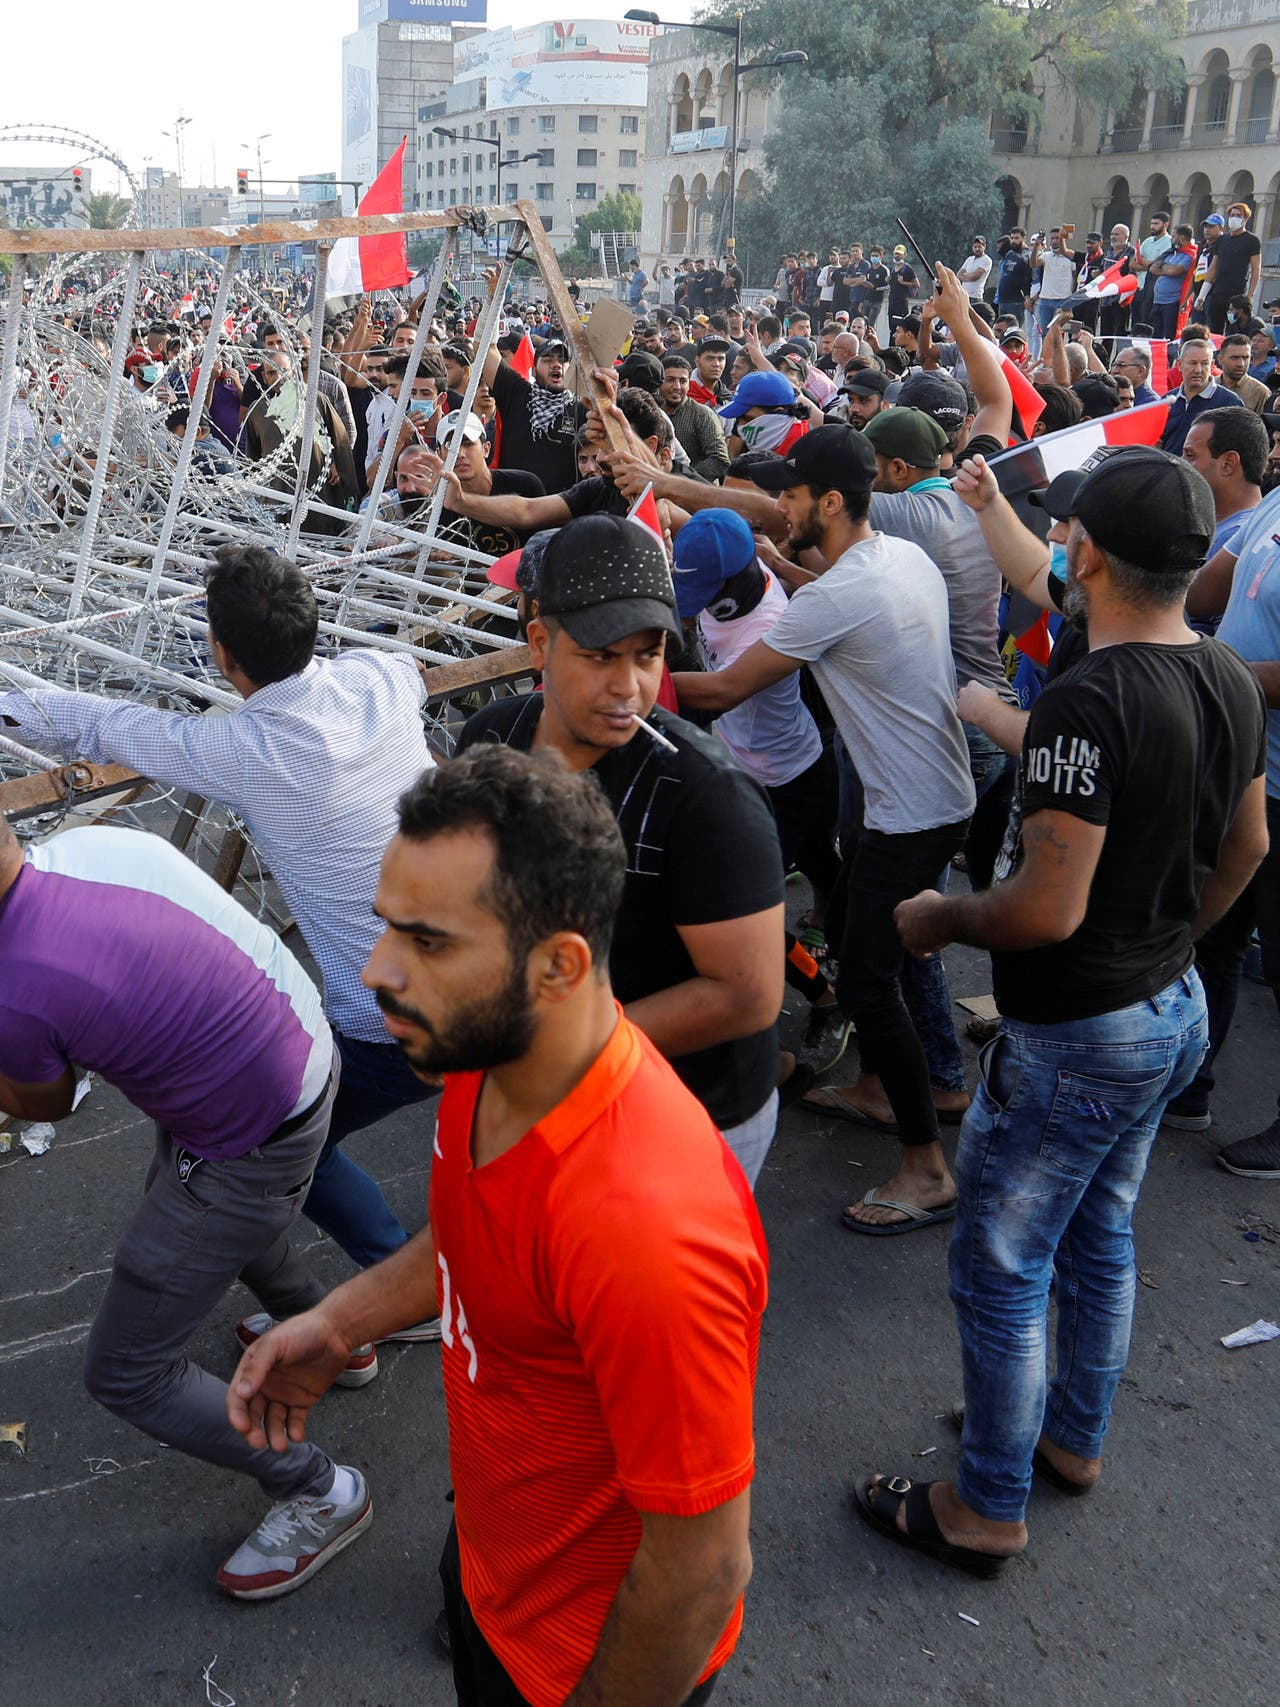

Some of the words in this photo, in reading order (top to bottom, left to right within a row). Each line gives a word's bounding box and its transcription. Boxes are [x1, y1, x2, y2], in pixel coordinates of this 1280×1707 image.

[409, 0, 468, 8] SAMSUNG
[616, 23, 658, 37] VESTEL
[933, 407, 961, 416] LACOSTE
[1027, 748, 1051, 782] NO
[1054, 735, 1101, 769] LIM
[1053, 765, 1096, 796] ITS
